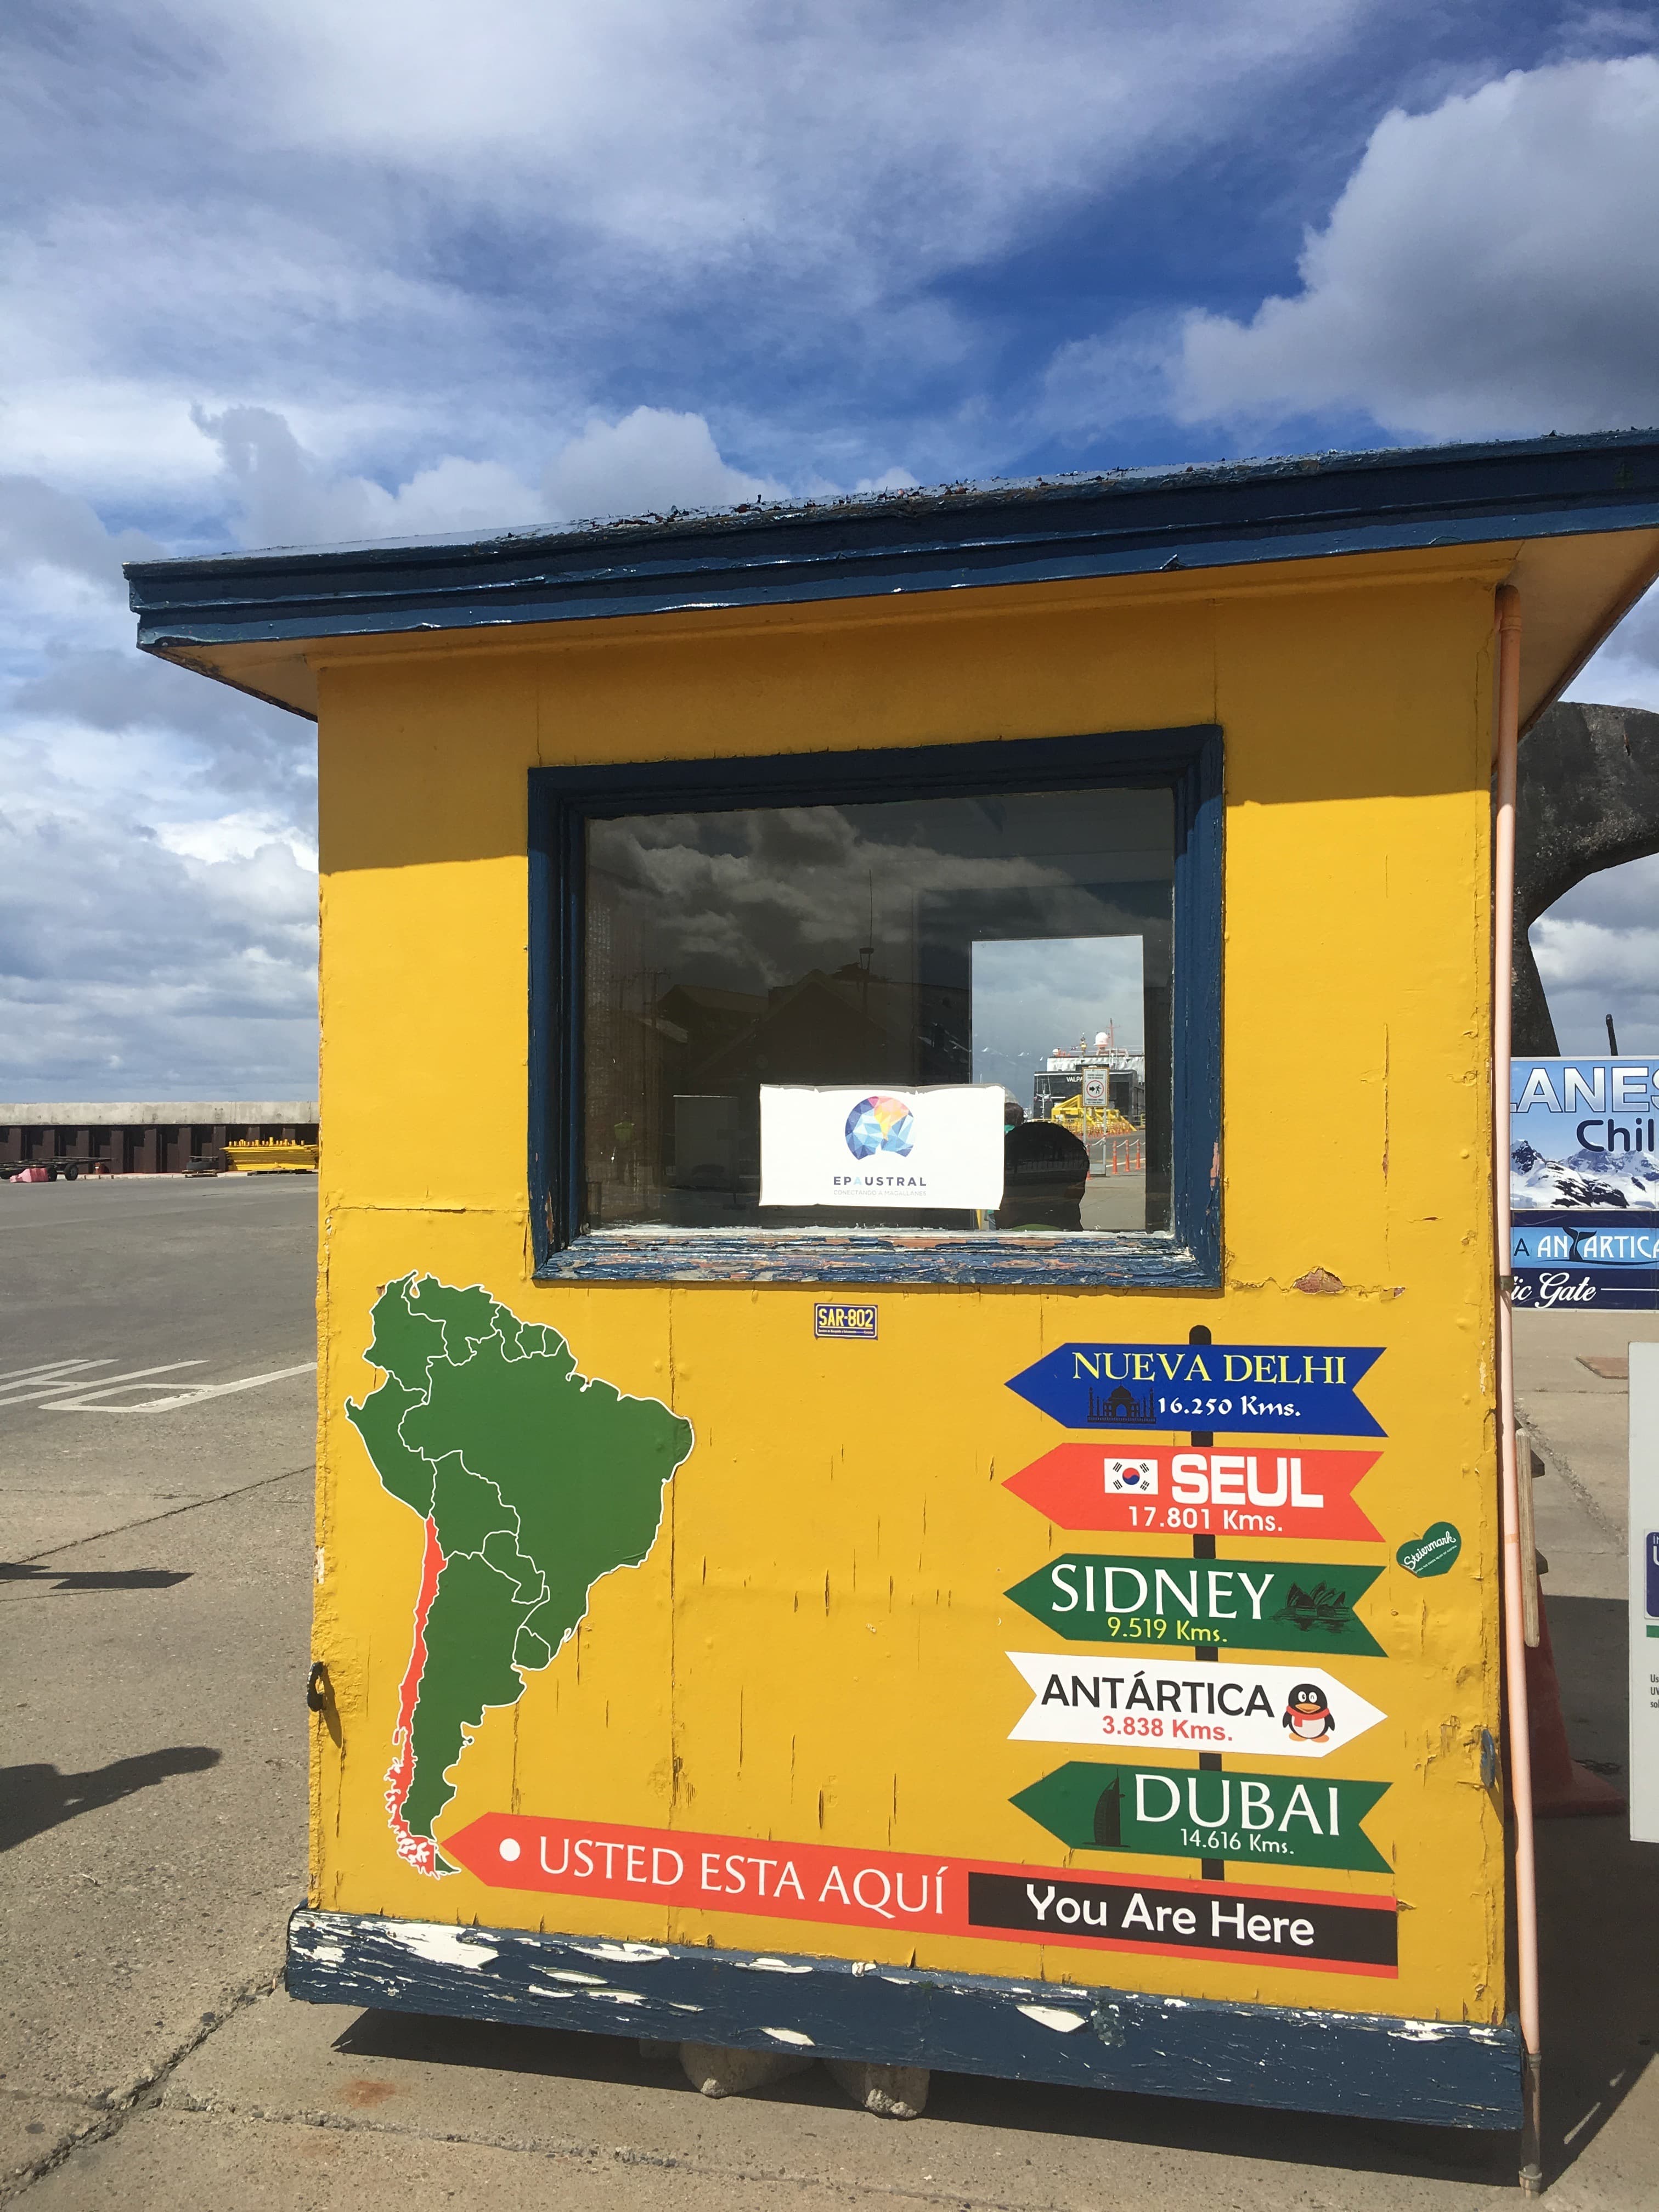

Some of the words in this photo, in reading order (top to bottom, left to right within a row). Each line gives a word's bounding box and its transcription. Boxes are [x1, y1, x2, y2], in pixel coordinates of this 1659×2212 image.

[1510, 1066, 1659, 1113] ANE
[833, 1176, 927, 1187] EPAUSTRAL
[1534, 1272, 1596, 1308] Gate
[819, 1308, 873, 1328] SAR-802
[1072, 1352, 1212, 1381] NUEVA
[1223, 1355, 1346, 1384] DELHI
[1158, 1397, 1232, 1415] 16.250
[1240, 1395, 1301, 1417] Kms.
[1171, 1453, 1324, 1508] SEUL
[1128, 1506, 1209, 1529] 17.801
[1223, 1509, 1283, 1532] Kms.
[1404, 1531, 1457, 1570] Steiermark
[1052, 1564, 1276, 1620] SIDNEY
[1108, 1616, 1167, 1639] 9.519
[1177, 1620, 1227, 1643] Kms.
[1041, 1670, 1275, 1718] ANTÁRTICA
[1103, 1715, 1164, 1737] 3.838
[1172, 1719, 1233, 1741] Kms.
[1135, 1774, 1340, 1837] DUBAI
[1181, 1827, 1242, 1850] 14.616
[1250, 1833, 1294, 1854] Kms.
[540, 1836, 684, 1885] USTED
[701, 1853, 805, 1900] ESTA
[819, 1866, 949, 1919] AQUÍ
[1026, 1883, 1107, 1926] You
[1121, 1893, 1196, 1934] Are
[1211, 1900, 1315, 1946] Here
